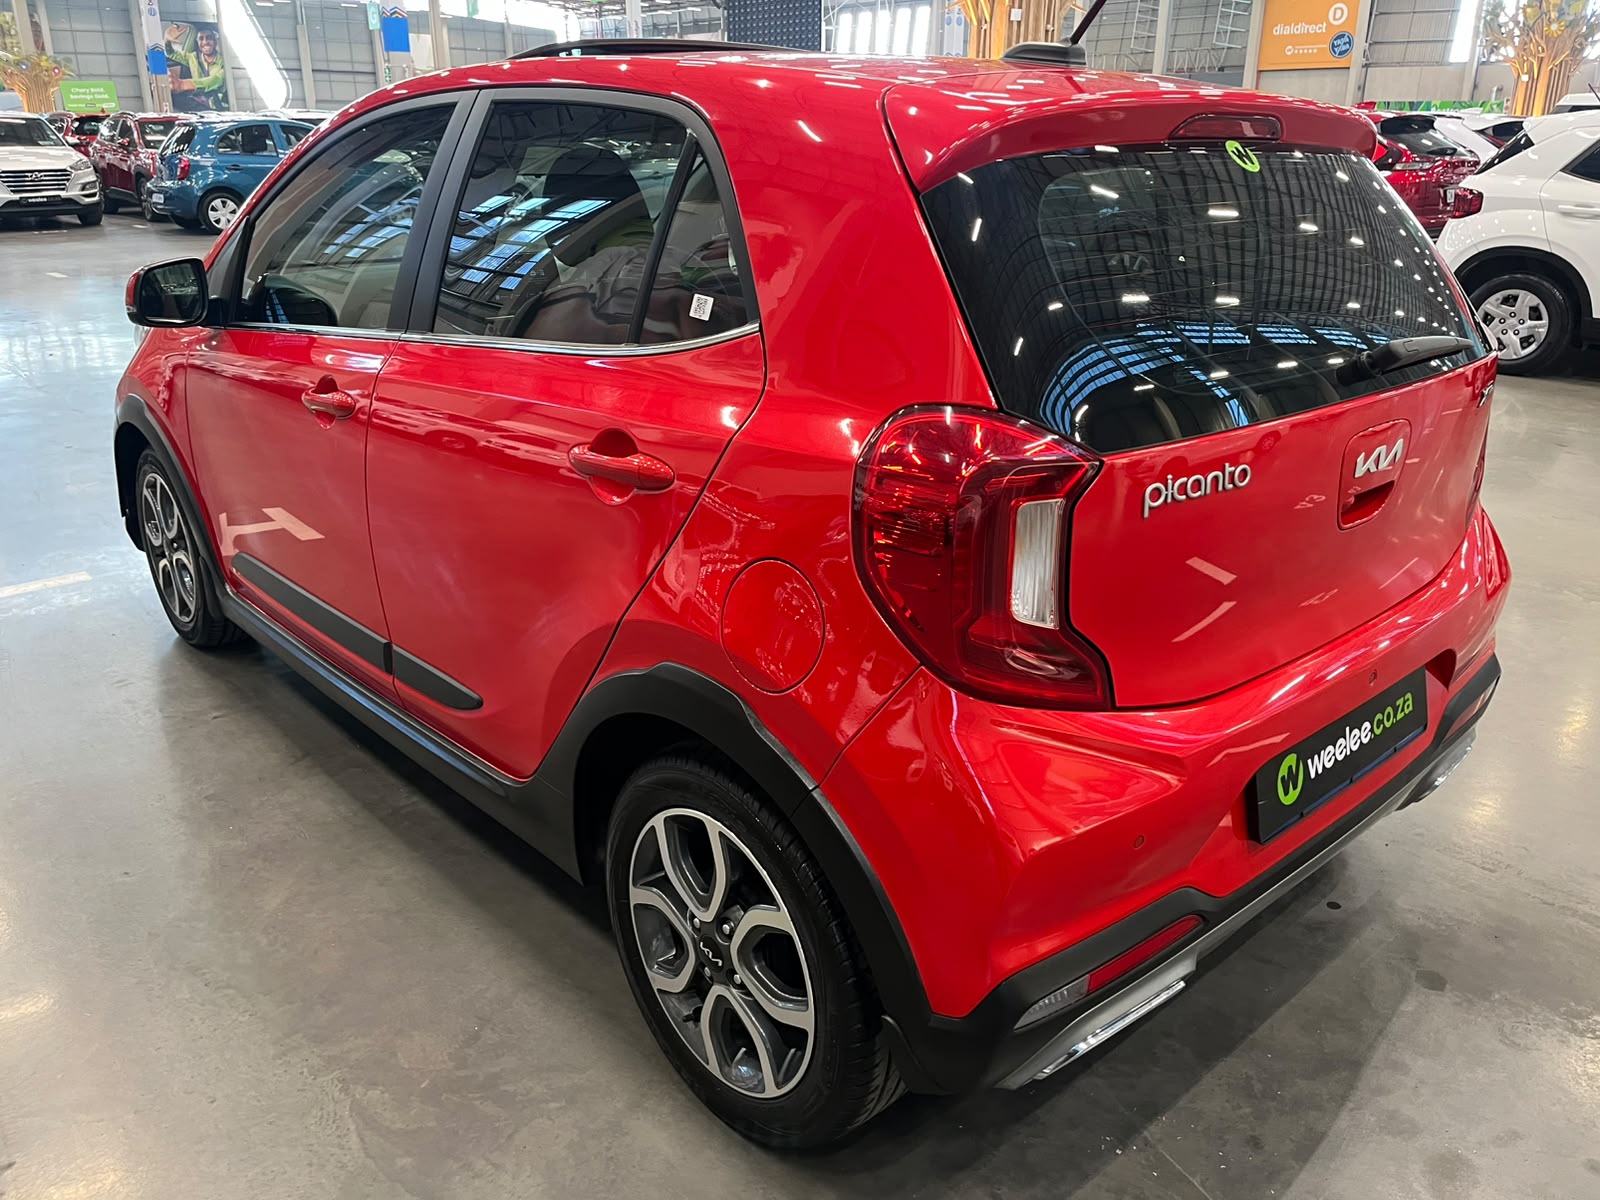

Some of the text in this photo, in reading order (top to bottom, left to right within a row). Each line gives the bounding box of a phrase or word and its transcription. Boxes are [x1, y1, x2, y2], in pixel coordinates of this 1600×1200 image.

[1272, 21, 1327, 36] dialdirect
[1354, 438, 1404, 479] KIA
[1143, 462, 1251, 519] picanto
[1307, 692, 1413, 780] weelee.co.za
